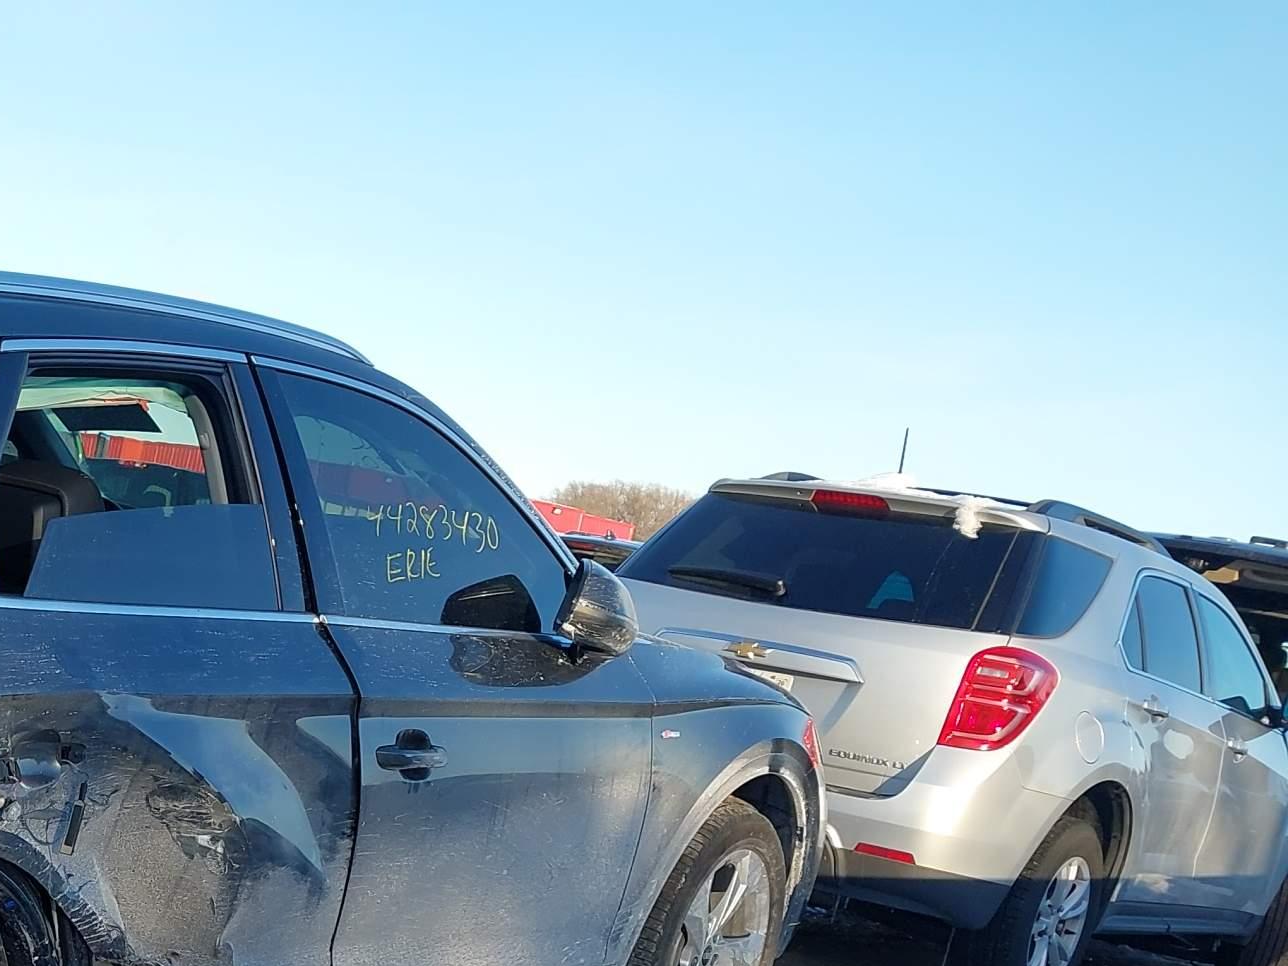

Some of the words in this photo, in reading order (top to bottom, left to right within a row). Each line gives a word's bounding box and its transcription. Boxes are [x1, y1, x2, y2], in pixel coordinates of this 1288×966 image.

[367, 501, 499, 553] 44283430
[386, 546, 441, 583] ERIE
[829, 749, 889, 768] EQUINOX
